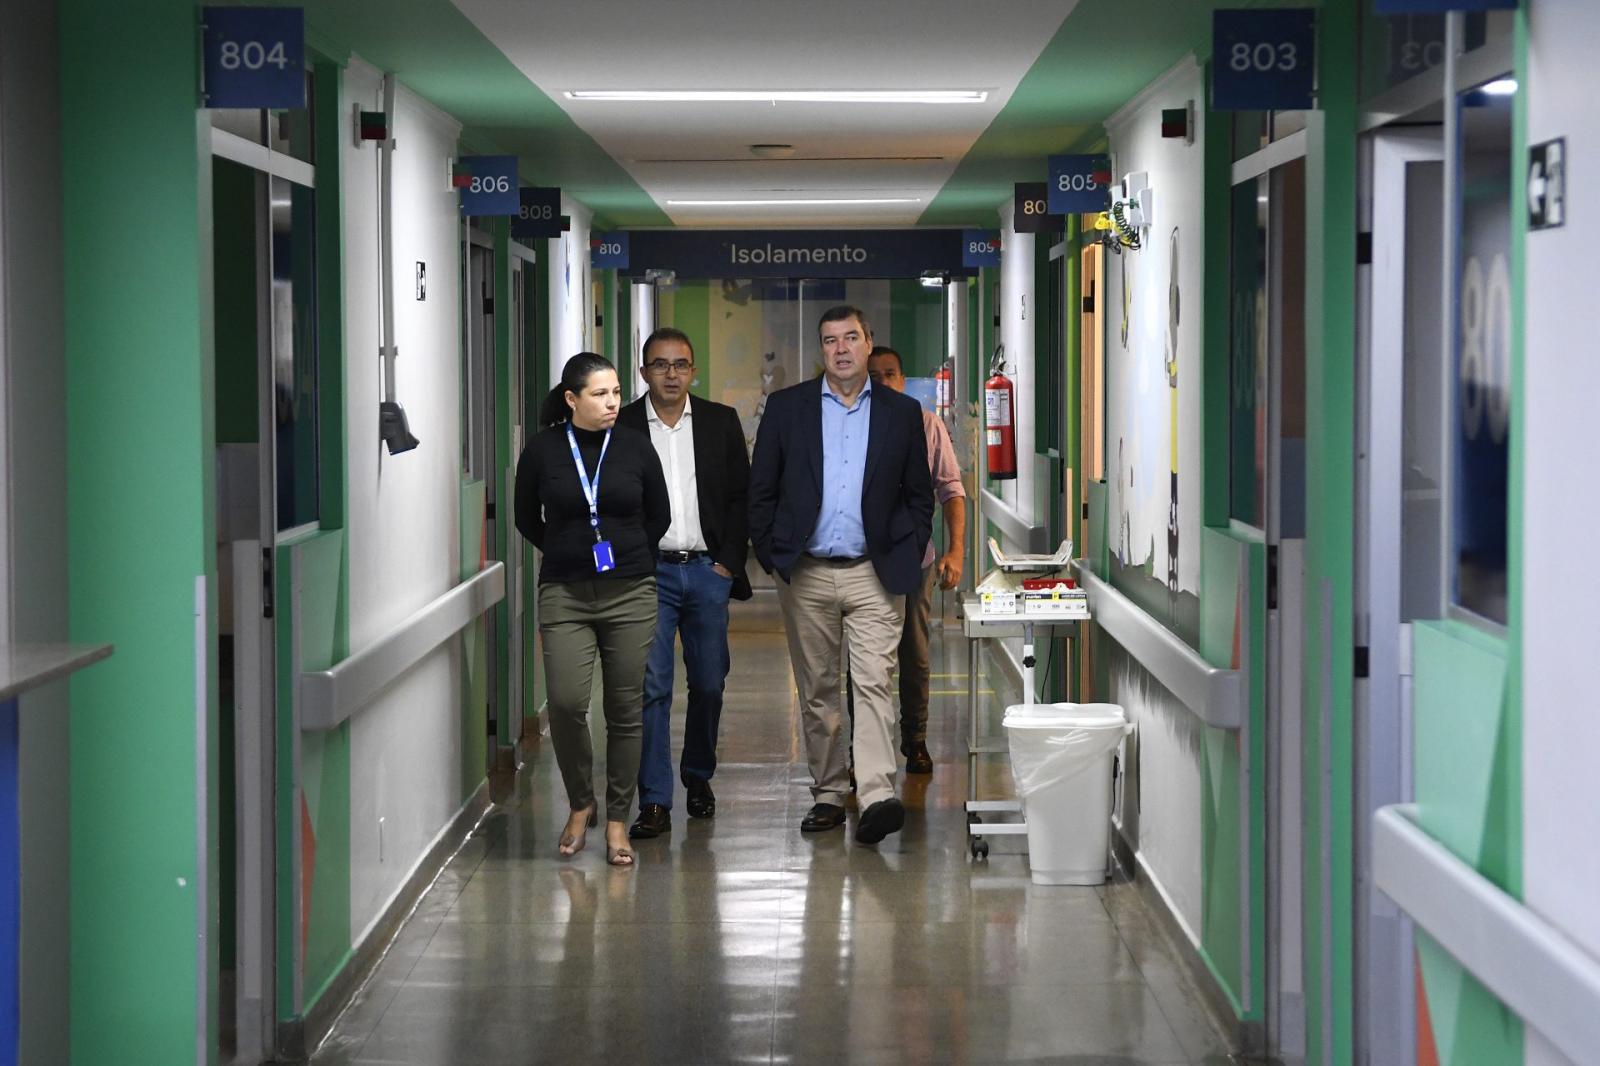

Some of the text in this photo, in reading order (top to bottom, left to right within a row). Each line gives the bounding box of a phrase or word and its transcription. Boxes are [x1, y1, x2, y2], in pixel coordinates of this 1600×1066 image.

[220, 41, 288, 70] 804
[1230, 42, 1297, 71] 803
[469, 175, 509, 193] 806
[1058, 174, 1097, 191] 805
[519, 205, 553, 220] 808
[1023, 200, 1047, 215] 80
[599, 243, 621, 255] 810
[731, 243, 867, 263] Isolamento
[969, 241, 995, 253] 809
